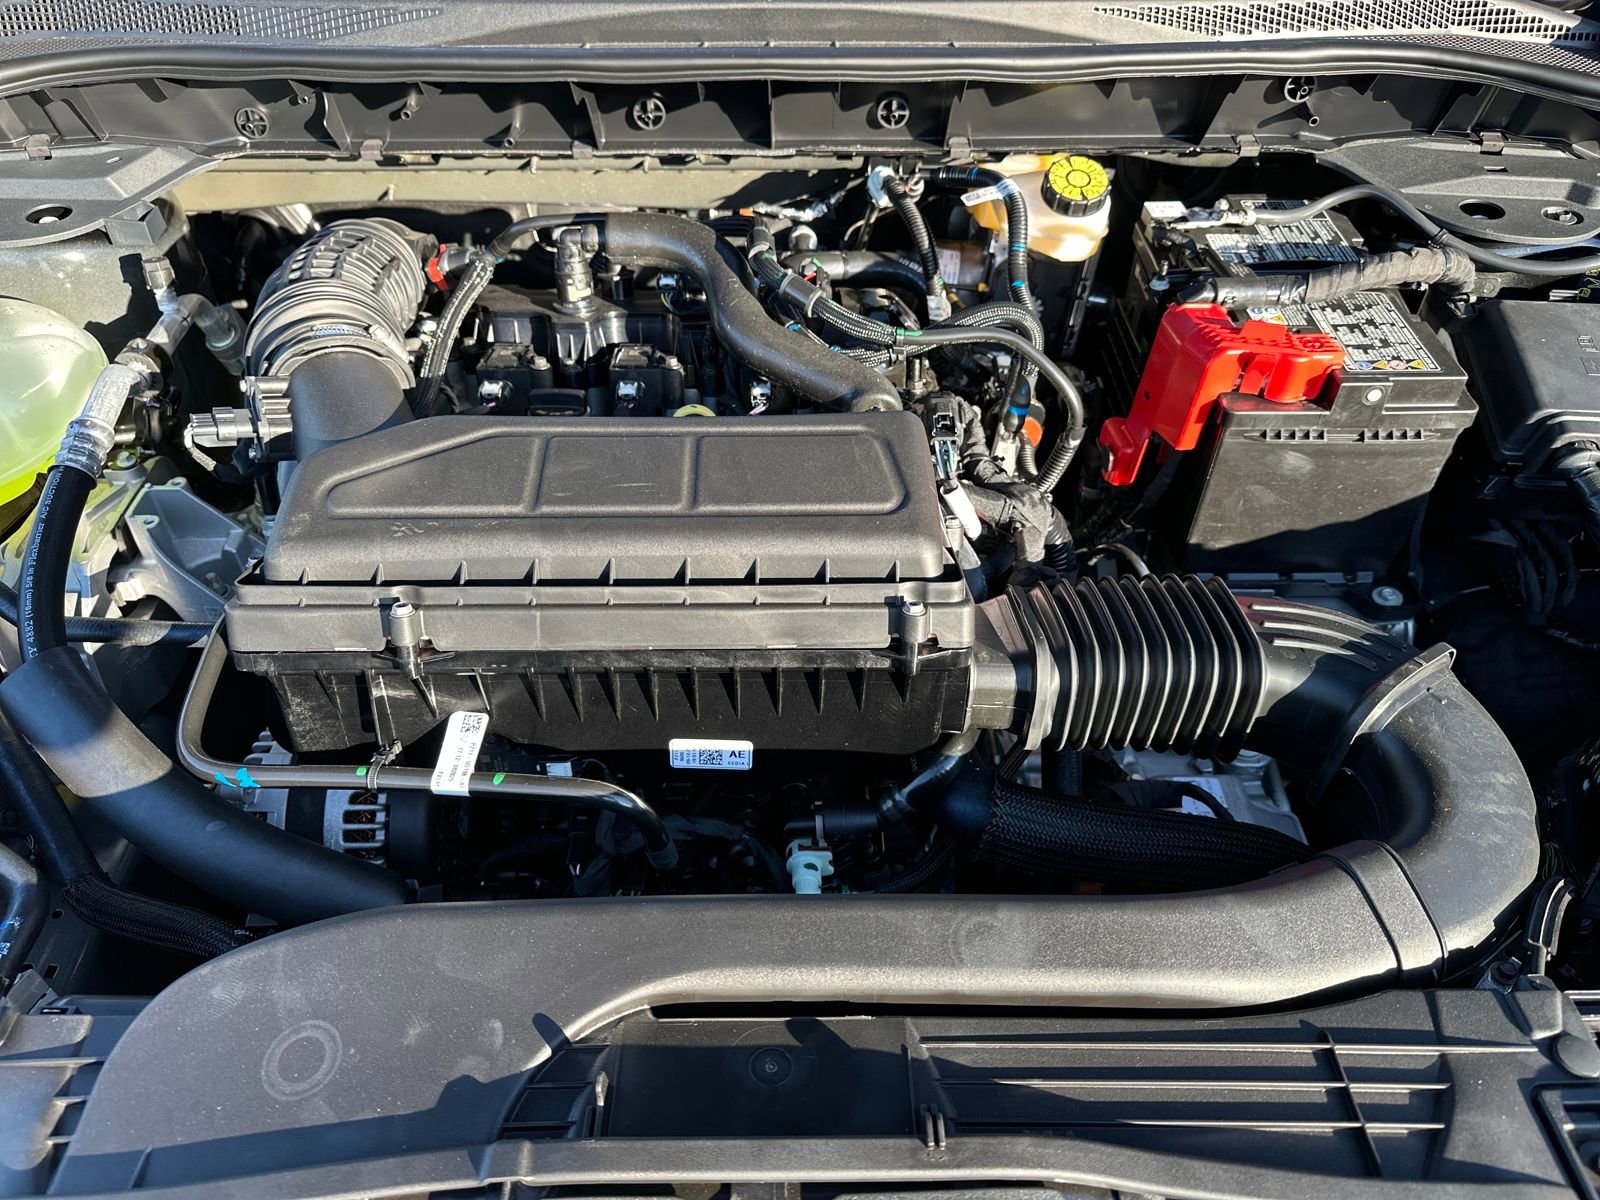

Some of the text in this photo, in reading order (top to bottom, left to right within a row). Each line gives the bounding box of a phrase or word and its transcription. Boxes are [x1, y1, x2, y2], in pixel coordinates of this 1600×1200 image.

[45, 471, 62, 505] SUCTION
[28, 522, 44, 566] Flexbarrier
[25, 620, 34, 642] 4882
[729, 750, 745, 758] AE
